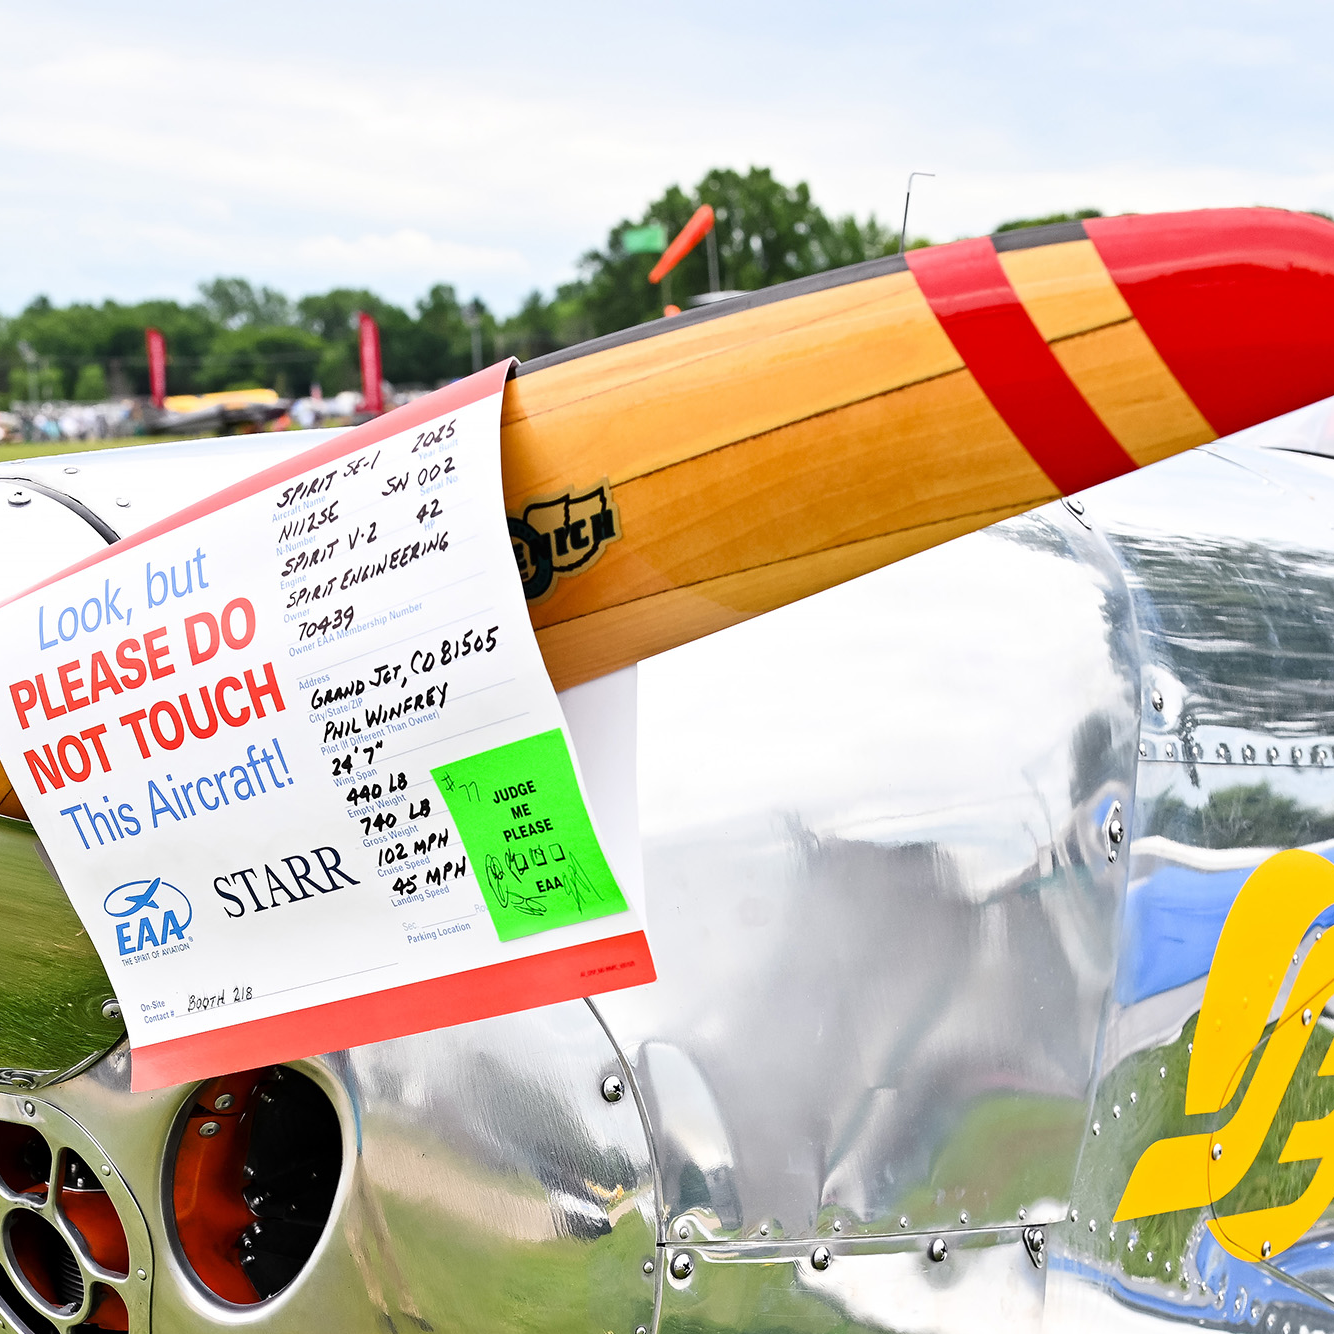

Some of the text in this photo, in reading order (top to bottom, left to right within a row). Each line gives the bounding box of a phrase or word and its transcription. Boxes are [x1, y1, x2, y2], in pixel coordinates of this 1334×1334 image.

[411, 419, 456, 453] 2025
[418, 439, 459, 461] Year Built
[277, 450, 381, 508] SPIRIT SE-1
[381, 457, 456, 496] SN 002
[419, 481, 444, 497] Serial
[272, 495, 326, 523] Aircraft Name
[278, 501, 339, 544] N112SE
[416, 499, 443, 524] 42
[424, 519, 436, 532] HP
[276, 535, 317, 556] N-Number
[281, 538, 339, 577] SPIRIT
[280, 574, 307, 591] Engine
[286, 531, 449, 609] SPIRIT ENGINEERING
[39, 547, 210, 651] Look, but
[283, 608, 310, 624] Owner
[298, 605, 354, 641] 70439
[288, 602, 423, 658] Owner EAA Membership Number
[9, 597, 256, 730] PLEASE DO
[311, 680, 365, 711] GRAND
[440, 625, 499, 666] 81505
[298, 673, 331, 691] Address
[309, 697, 364, 724] City/State/ZIP
[323, 682, 448, 743] PHIL WINFREY
[23, 662, 286, 795] NOT TOUCH
[320, 709, 440, 756] Pilot (If Different Than Owner)
[332, 768, 378, 788] Wing Span
[346, 772, 408, 806] 440 LB
[60, 738, 294, 850] This Aircraft!
[493, 780, 537, 804] JUDGE
[347, 793, 407, 819] Empty Weight
[360, 798, 431, 835] 740 LB
[510, 803, 532, 820] ME
[362, 825, 419, 848] Gross Weight
[502, 818, 554, 843] PLEASE
[378, 828, 449, 867] 102 MPH
[377, 855, 431, 878] Cruise Speed
[392, 874, 417, 895] 45
[425, 855, 466, 886] MPH
[213, 846, 361, 919] STARR
[391, 884, 450, 908] Landing Speed
[535, 876, 564, 893] EAA
[116, 910, 185, 956] EAA
[407, 922, 471, 944] Parking Location
[121, 942, 190, 967] THE SPIRIT OF AVIATION
[140, 999, 165, 1012] On-Site
[187, 986, 253, 1012] BOOTH 218
[144, 1011, 170, 1024] Contact
